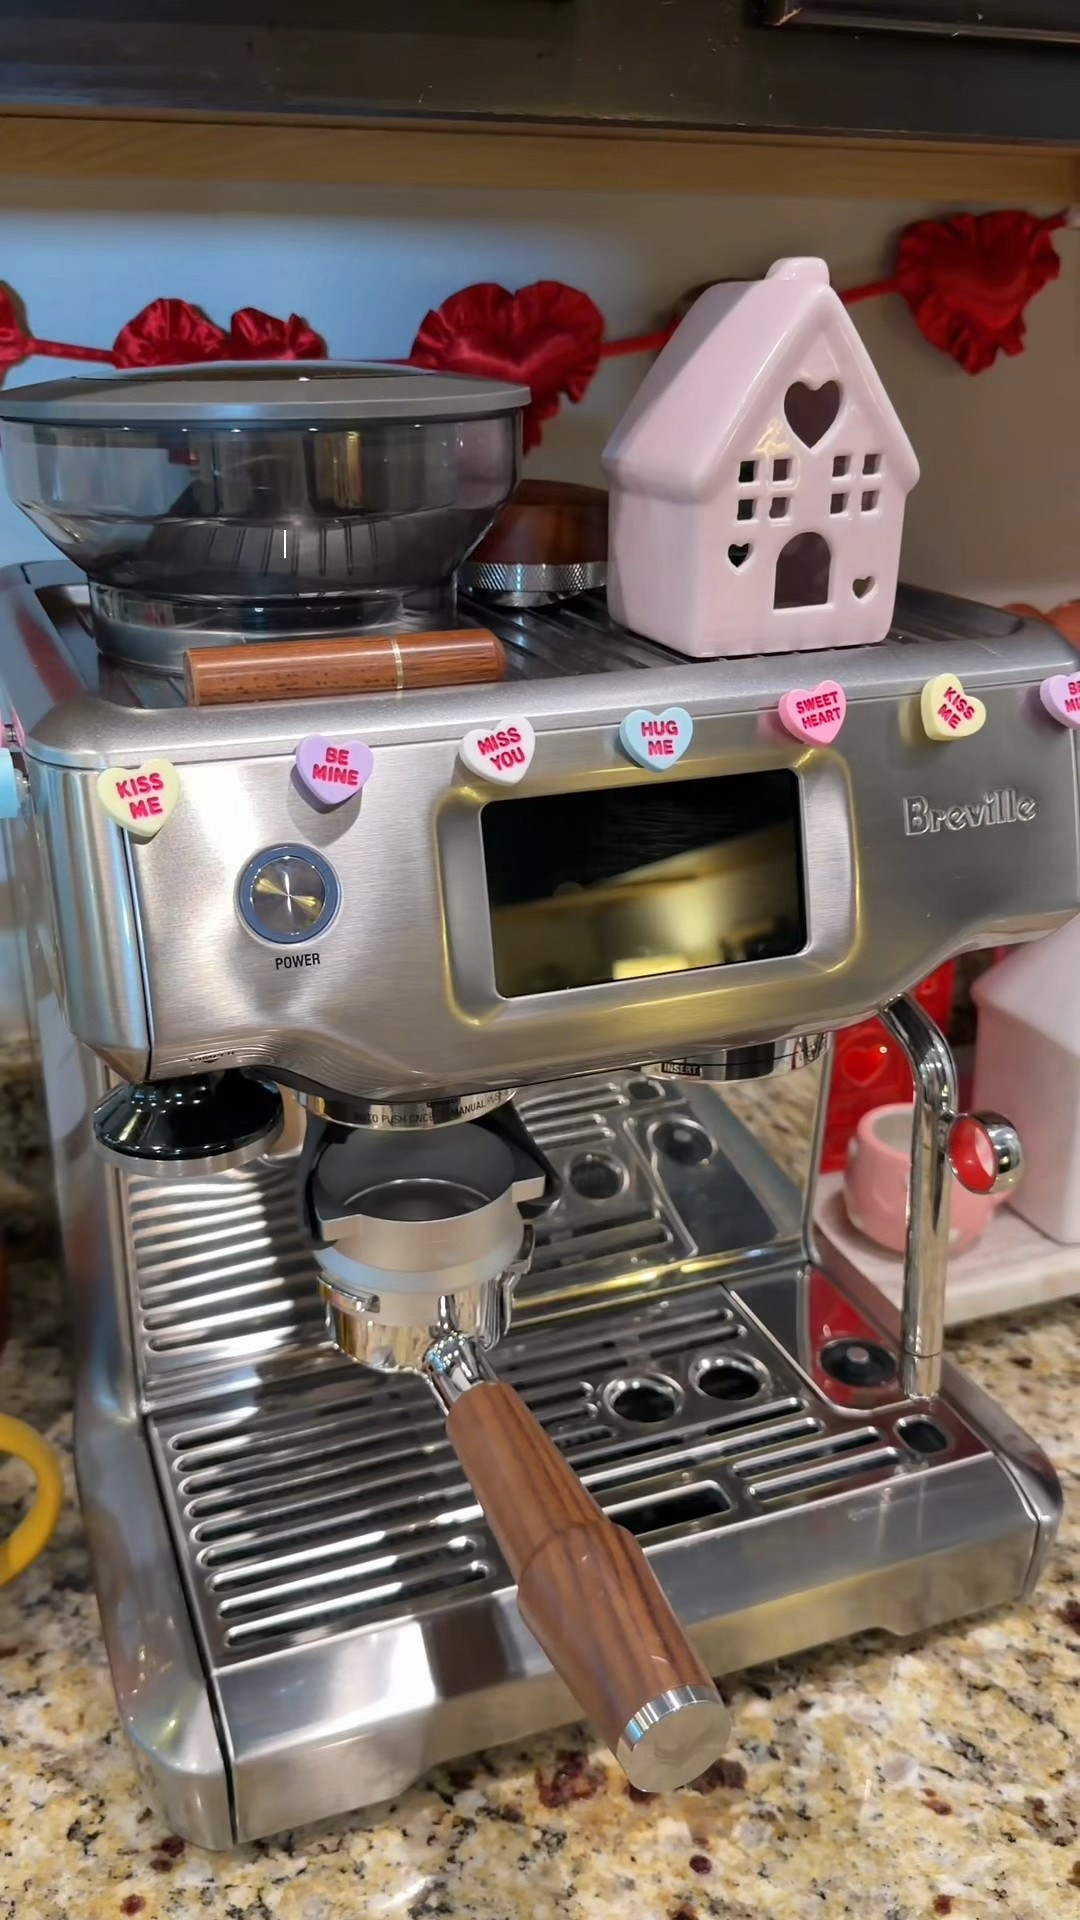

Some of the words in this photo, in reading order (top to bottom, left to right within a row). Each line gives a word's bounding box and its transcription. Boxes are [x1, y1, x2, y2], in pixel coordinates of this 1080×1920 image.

[795, 691, 839, 715] SWEET
[943, 686, 976, 721] KISS
[641, 720, 679, 737] HUG
[801, 707, 841, 730] HEART
[937, 703, 962, 730] ME
[477, 727, 522, 756] MISS
[648, 739, 674, 756] ME
[325, 746, 350, 766] BE
[490, 746, 526, 771] YOU
[115, 772, 164, 799] KISS
[312, 763, 359, 786] MINE
[129, 796, 163, 820] ME
[902, 788, 1038, 837] Breville
[275, 952, 321, 971] POWER
[663, 1063, 699, 1075] INSERT
